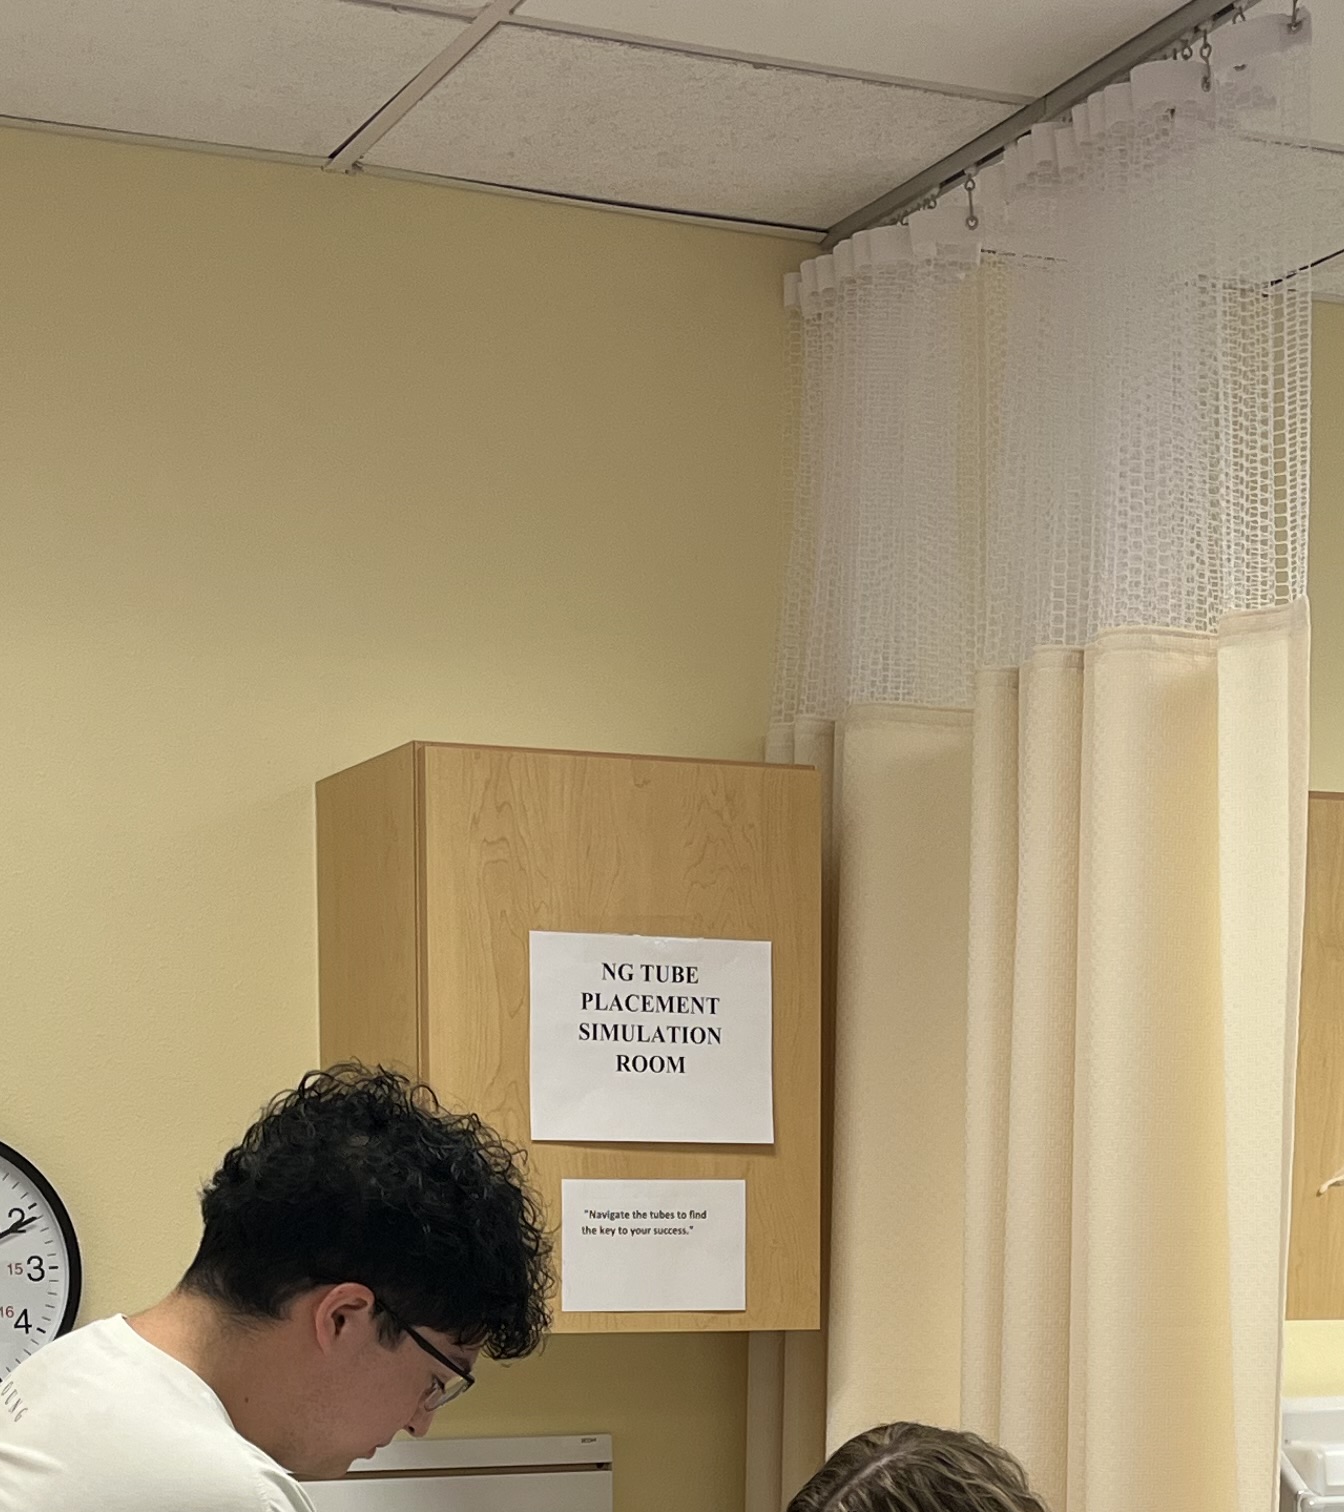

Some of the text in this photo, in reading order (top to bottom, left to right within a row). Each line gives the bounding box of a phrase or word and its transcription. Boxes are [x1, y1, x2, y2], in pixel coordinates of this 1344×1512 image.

[602, 962, 699, 985] NG TUBE
[581, 992, 721, 1015] PLACEMENT
[578, 1022, 722, 1045] SIMULATION
[616, 1054, 686, 1074] ROOM
[8, 1207, 26, 1233] 2
[585, 1209, 707, 1222] "Navigate the tubes to find
[582, 1225, 694, 1237] the key to your success."
[7, 1263, 23, 1276] 15
[26, 1256, 46, 1282] 3
[0, 1306, 15, 1319] 16
[14, 1309, 33, 1334] 4
